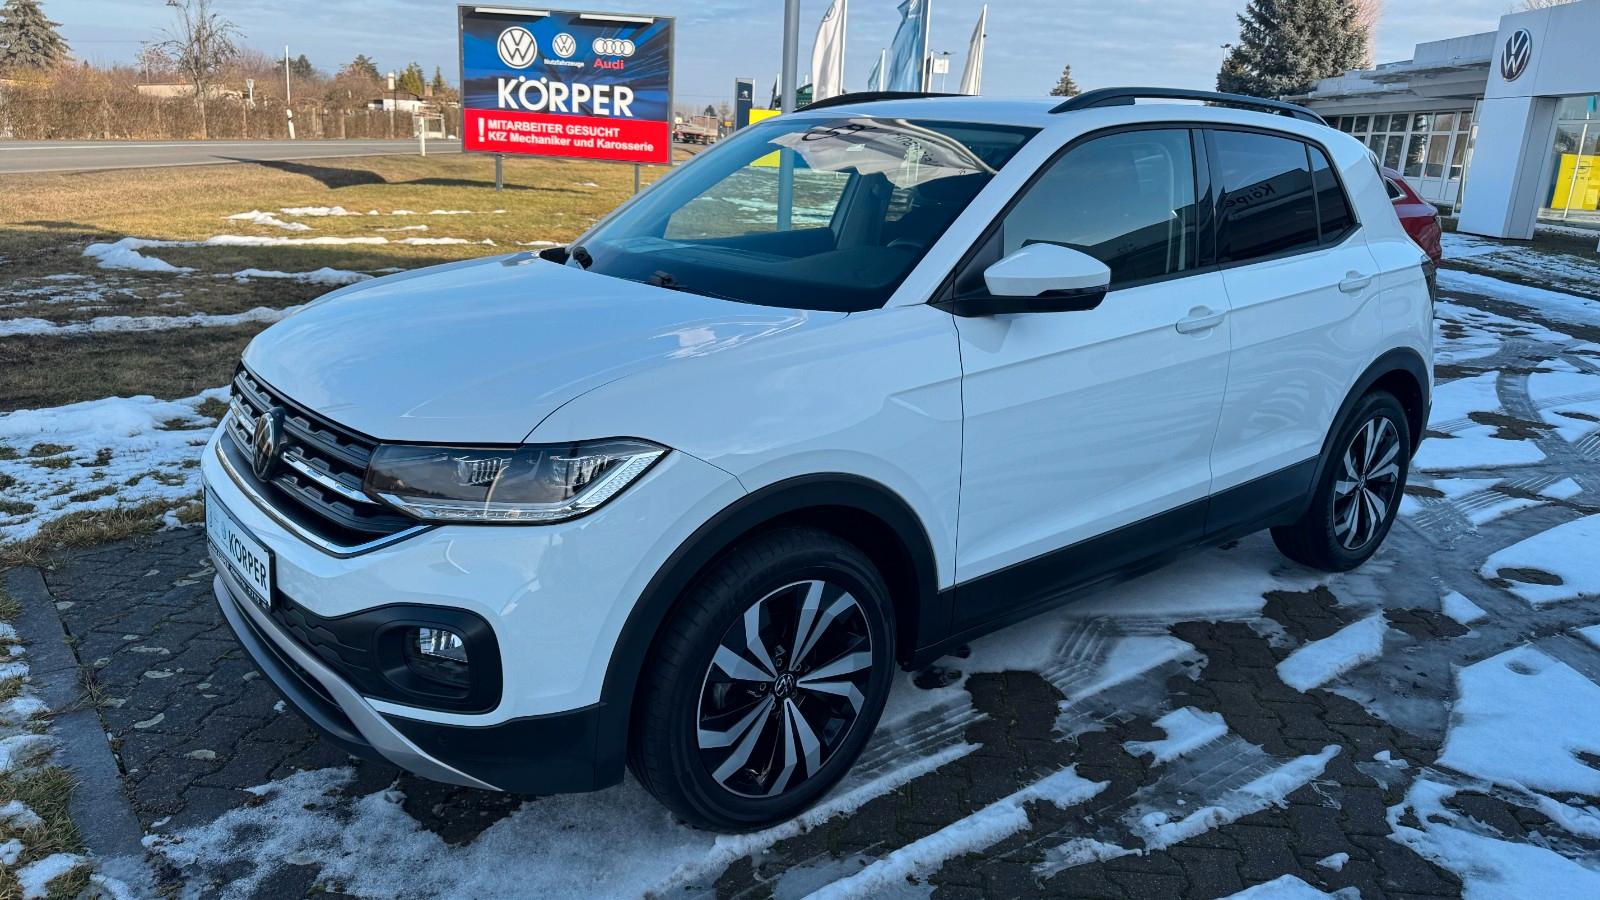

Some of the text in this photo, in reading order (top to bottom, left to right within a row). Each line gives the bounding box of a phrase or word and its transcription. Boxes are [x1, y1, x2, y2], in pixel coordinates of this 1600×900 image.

[593, 58, 625, 70] Audi
[497, 75, 634, 117] KÖRPER
[488, 119, 620, 138] MITARBEITER GESUCHT
[488, 131, 654, 152] KfZ Mechaniker und Karosserie
[228, 529, 268, 592] KÖRPER
